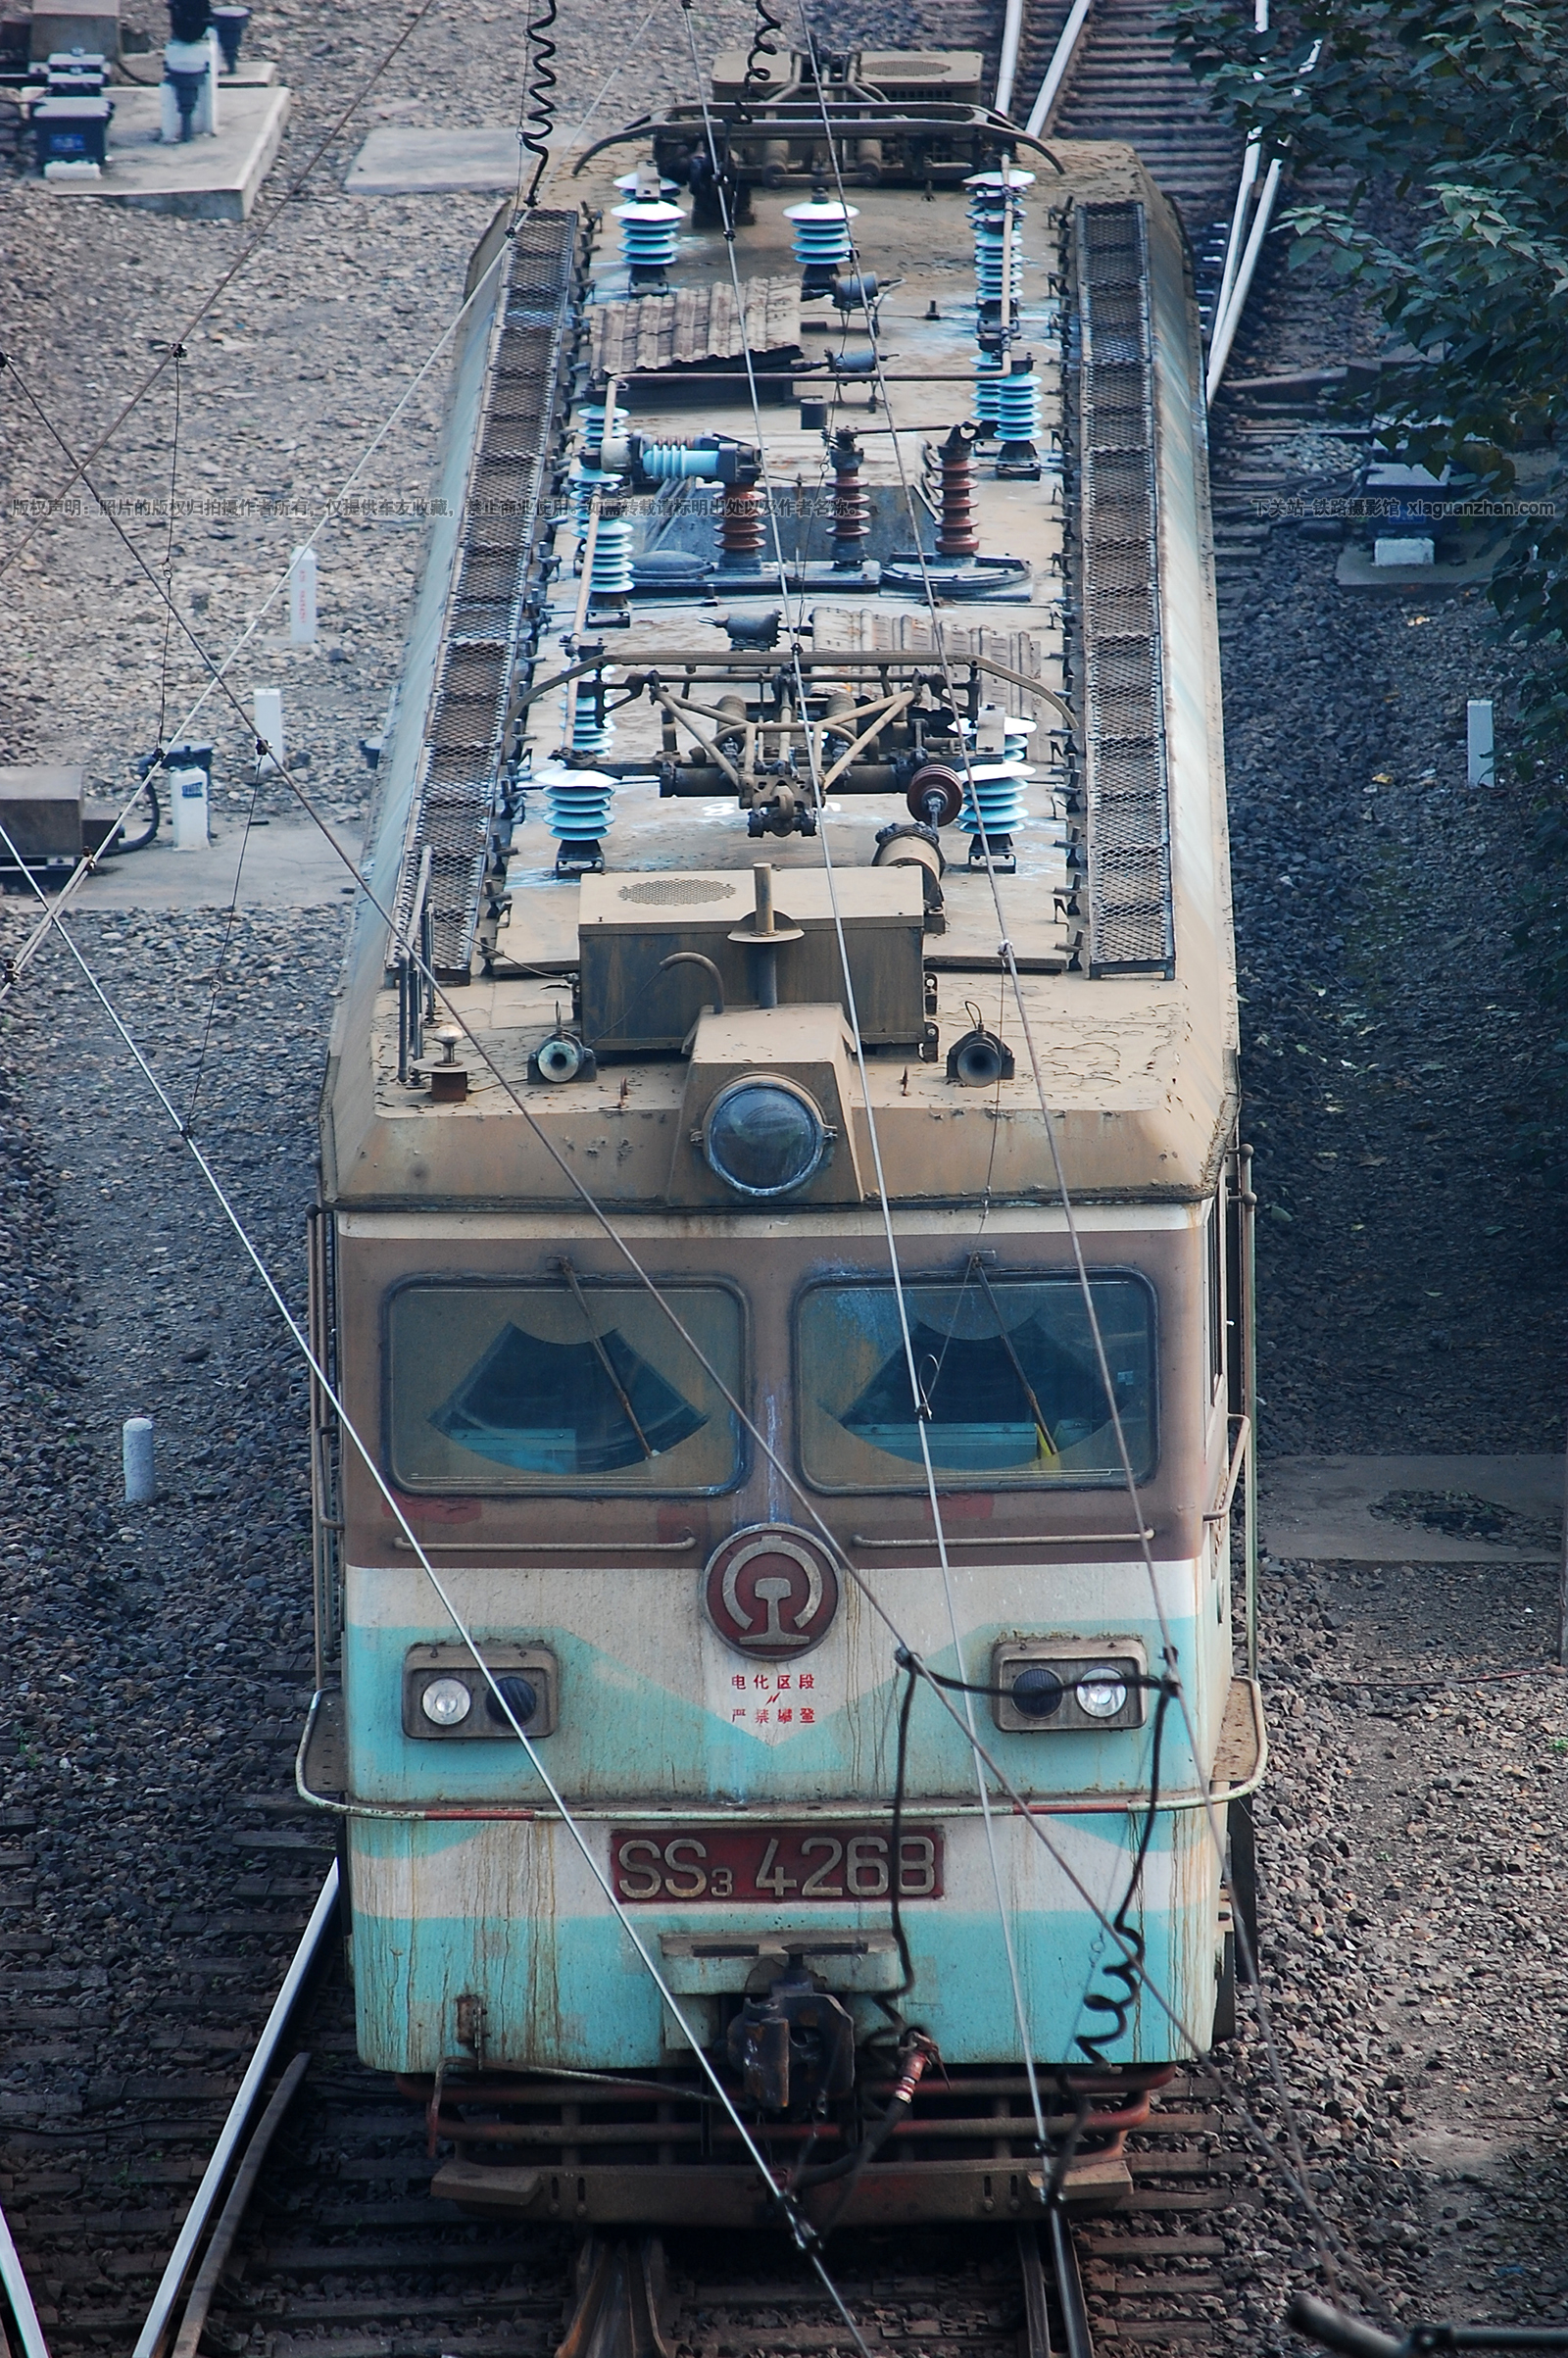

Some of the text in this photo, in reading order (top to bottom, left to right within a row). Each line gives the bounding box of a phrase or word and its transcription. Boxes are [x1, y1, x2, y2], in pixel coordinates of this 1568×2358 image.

[731, 1674, 814, 1690] 电化区段
[731, 1707, 815, 1724] 严禁攀登
[756, 1837, 935, 1897] 4268
